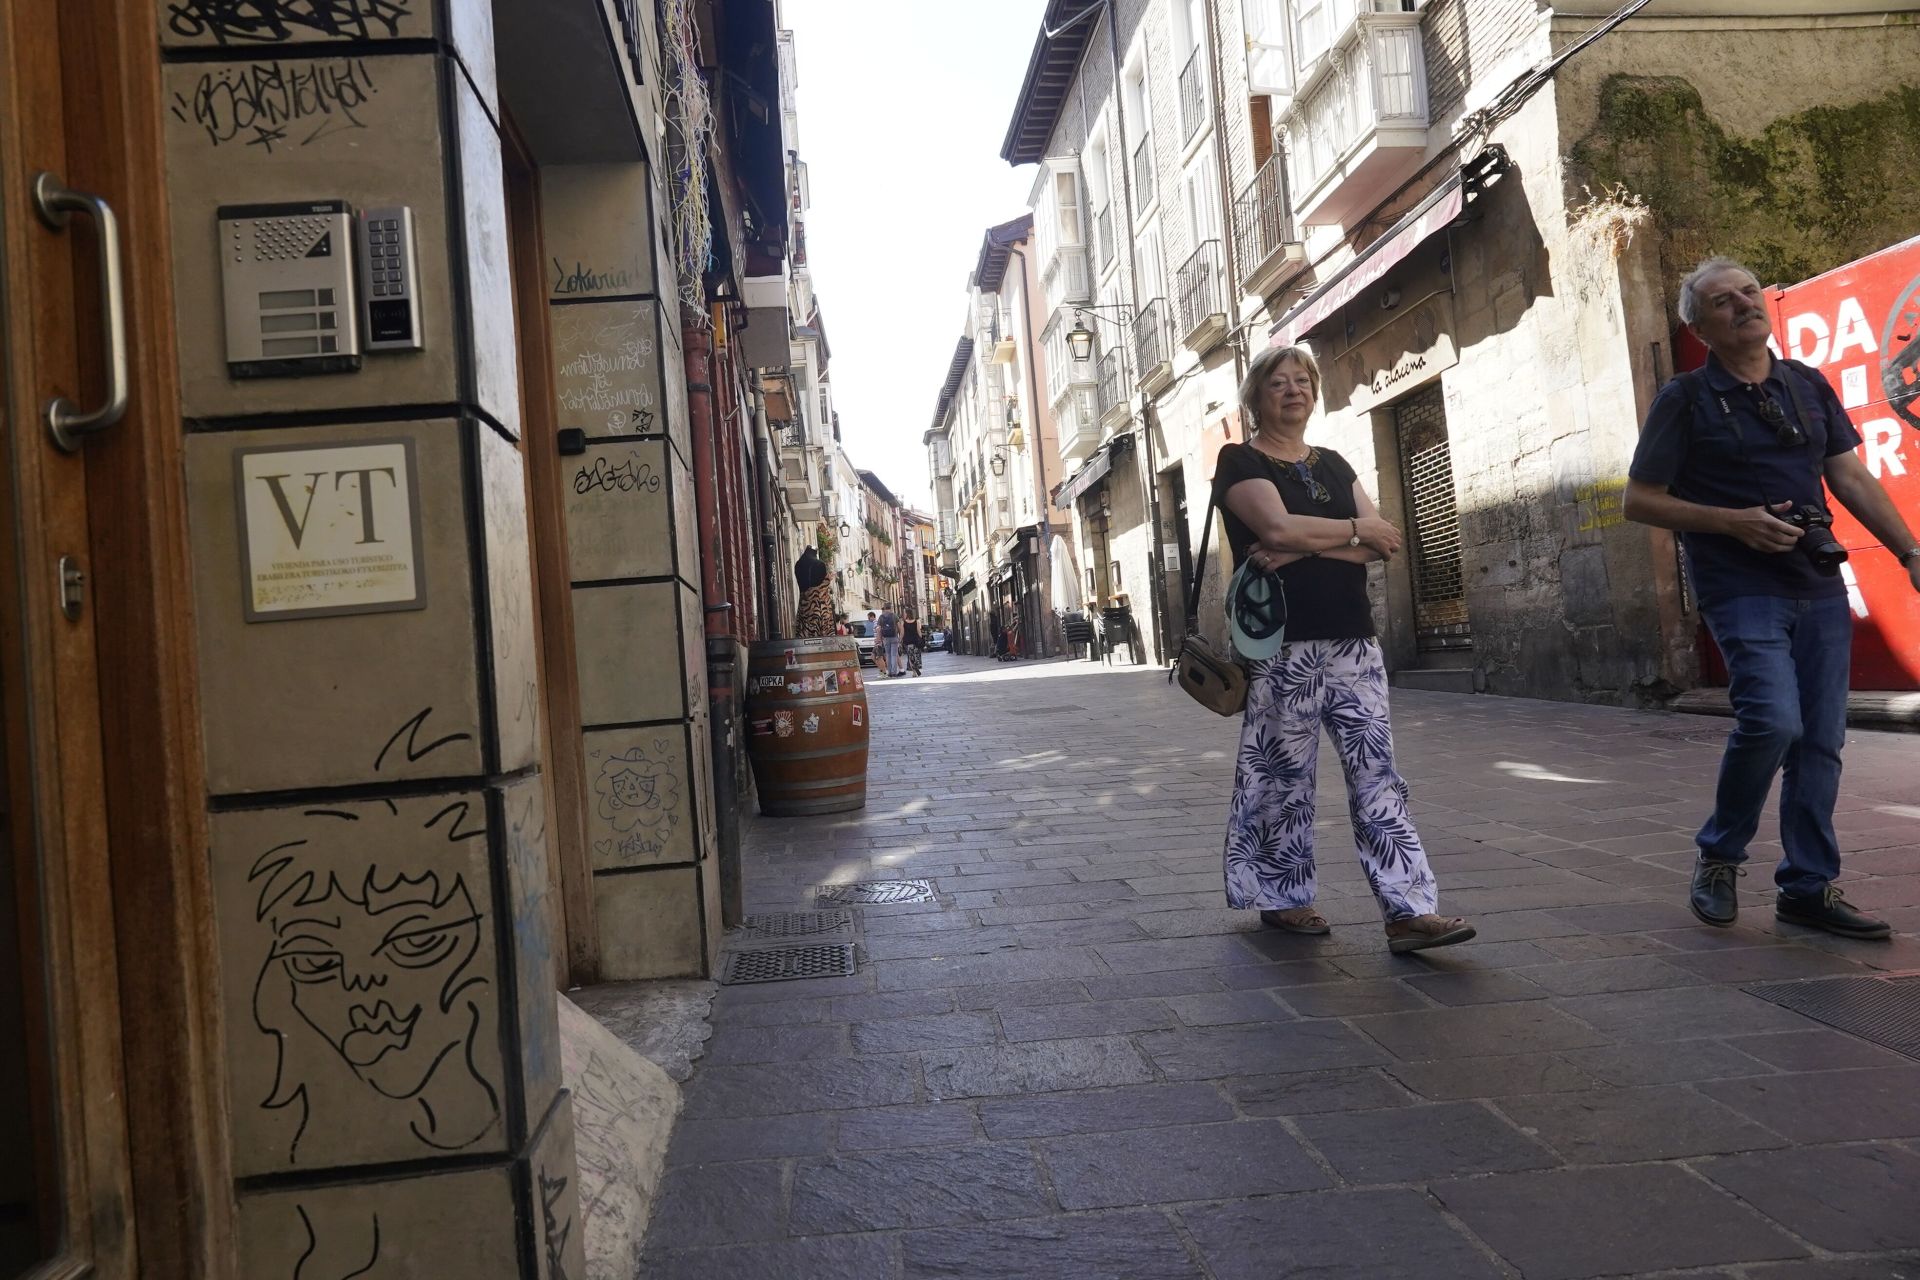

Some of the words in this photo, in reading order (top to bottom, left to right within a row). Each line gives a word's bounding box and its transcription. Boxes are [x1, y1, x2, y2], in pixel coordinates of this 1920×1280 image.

[1371, 370, 1382, 395] la
[1385, 356, 1426, 388] alacena
[1853, 416, 1908, 480] R
[256, 466, 396, 550] VT
